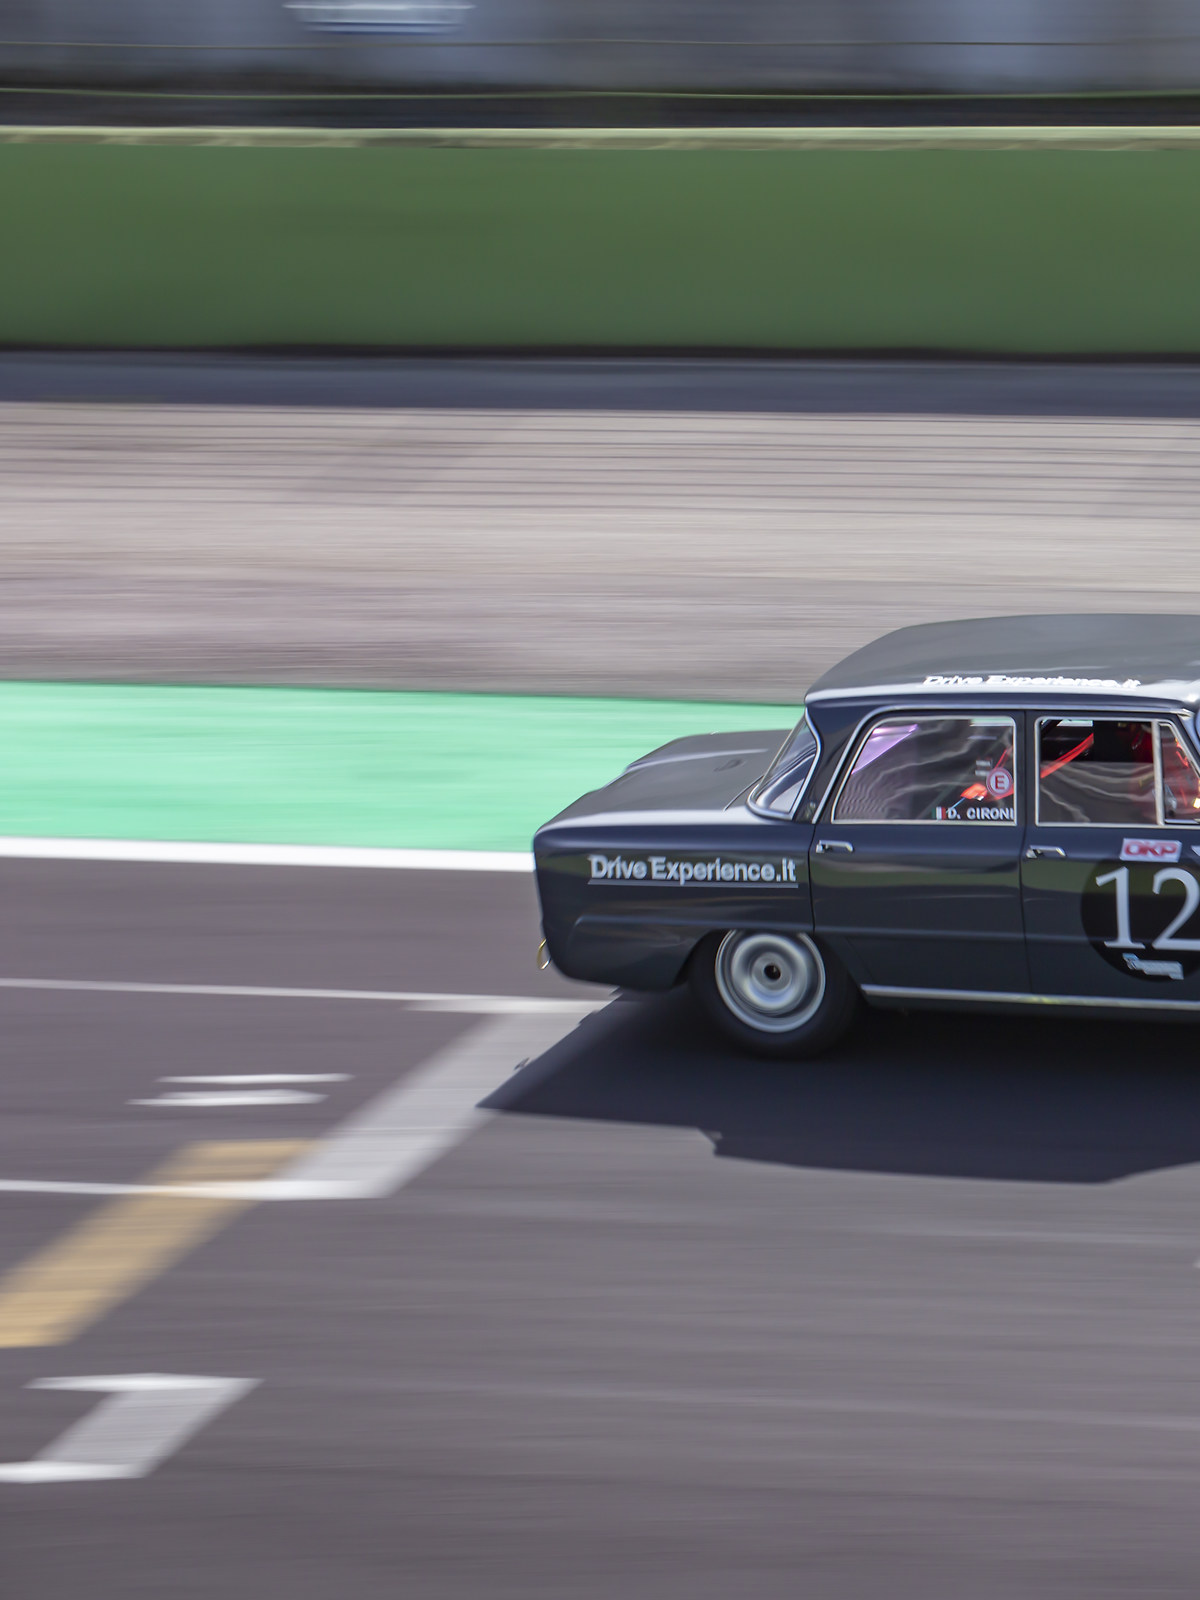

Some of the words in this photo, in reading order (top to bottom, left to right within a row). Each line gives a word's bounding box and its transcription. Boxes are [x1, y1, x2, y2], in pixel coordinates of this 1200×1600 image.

[923, 675, 983, 686] Drive
[986, 675, 1141, 689] Experience.it
[994, 775, 1005, 790] E
[948, 807, 961, 819] D.
[587, 854, 647, 879] Drive
[647, 856, 797, 886] Experience.it
